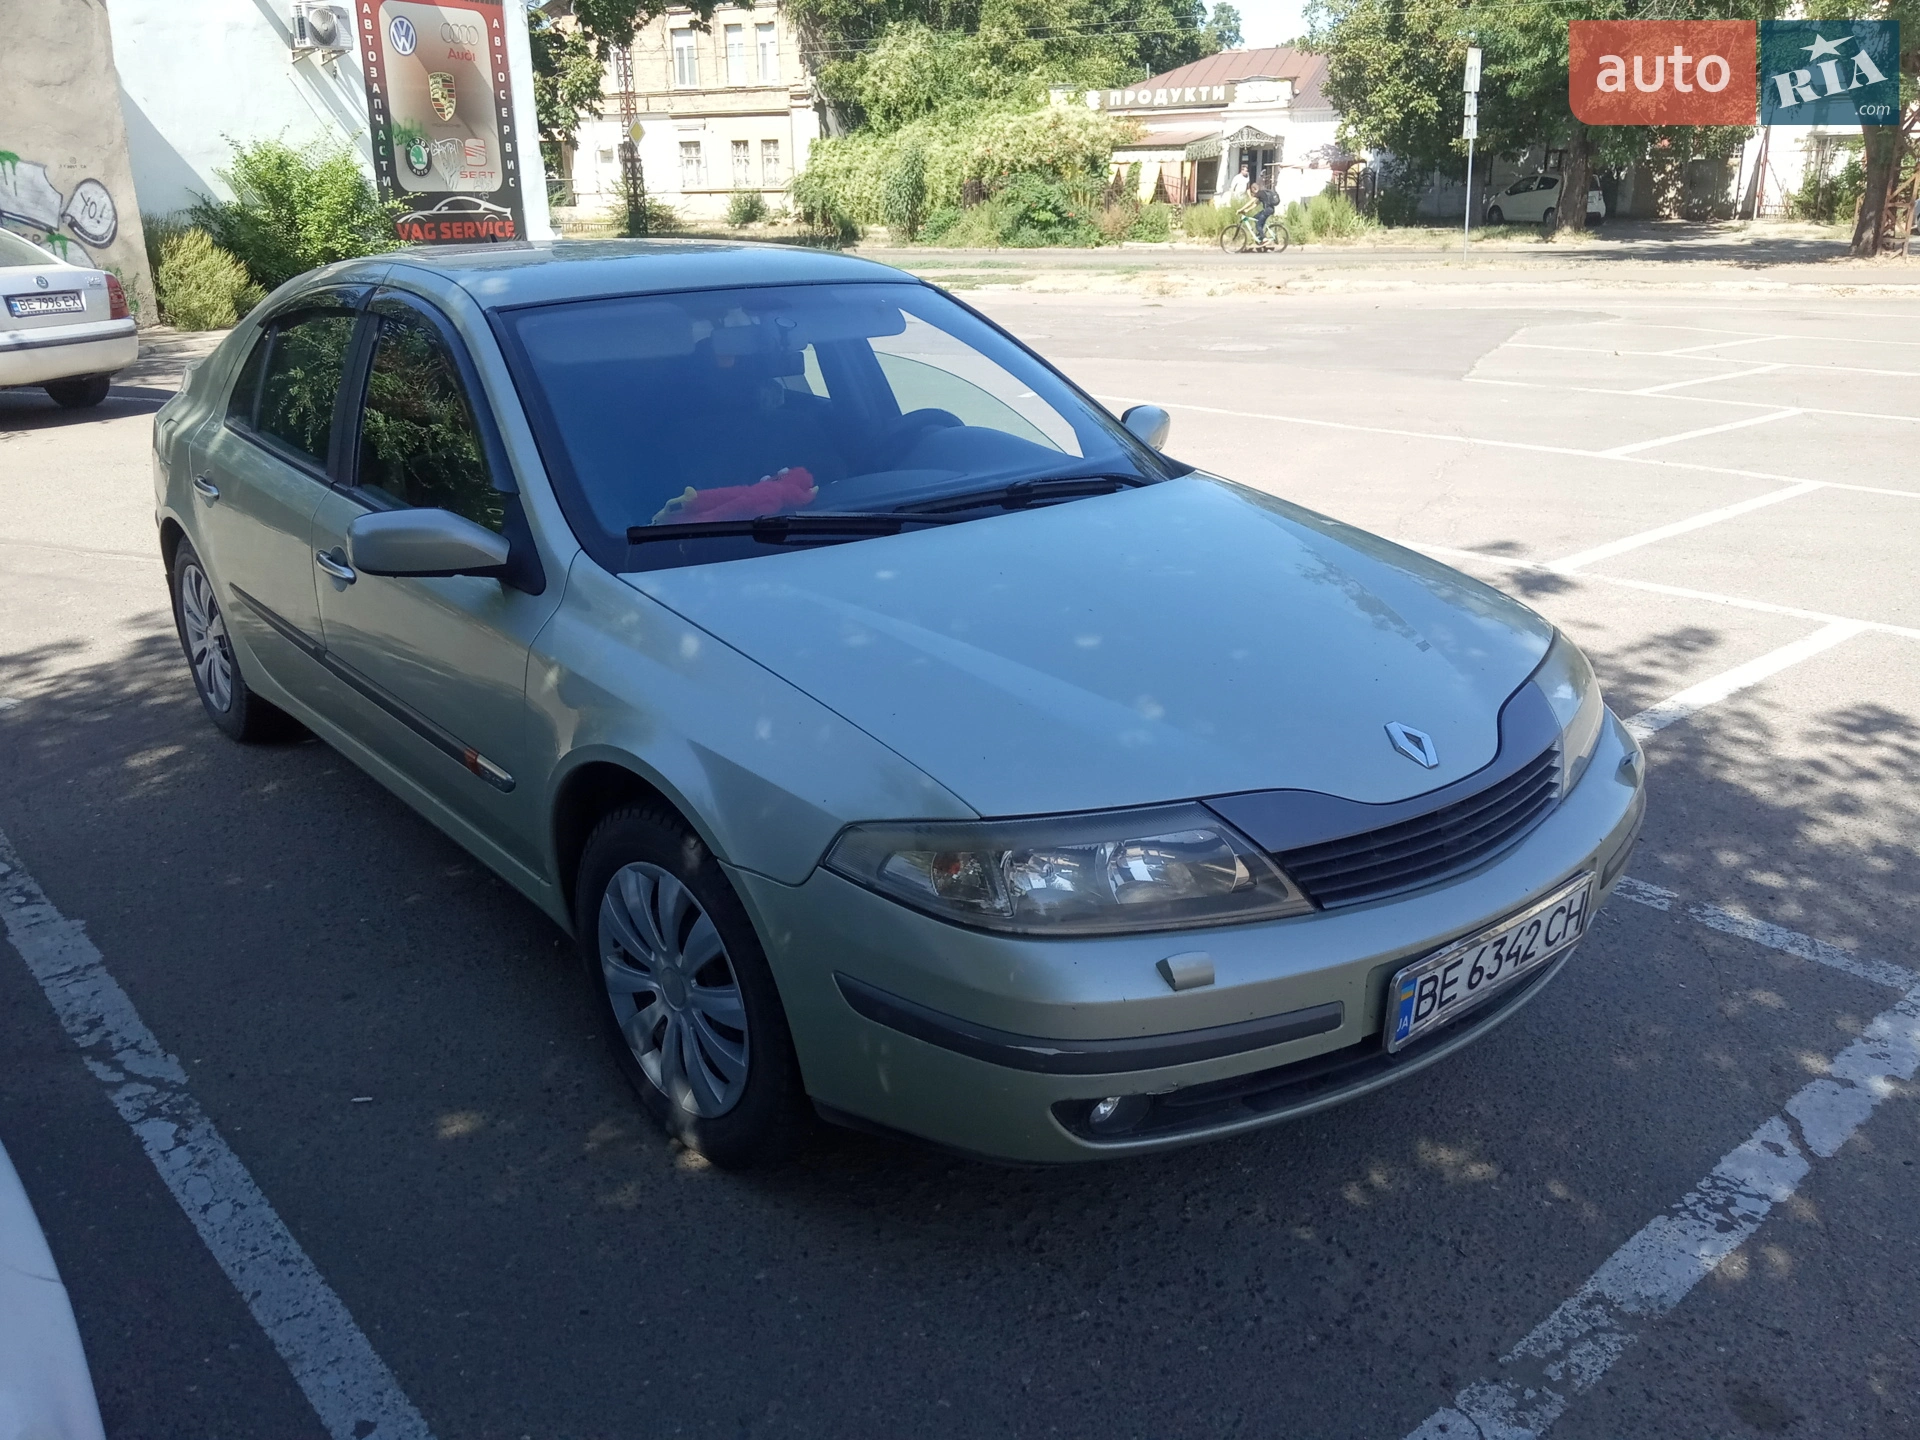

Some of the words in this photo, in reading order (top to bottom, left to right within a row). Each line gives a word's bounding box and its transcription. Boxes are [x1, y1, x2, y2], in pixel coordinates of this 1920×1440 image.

[447, 47, 476, 61] Audi
[362, 2, 391, 187] АВТОЗАПЧАСТИ
[492, 18, 515, 187] АВТОСЕРВИС
[1109, 85, 1225, 106] ПРОДУКТИ
[396, 222, 436, 240] VAG
[440, 221, 515, 239] SERVICE
[18, 298, 35, 311] BE
[35, 297, 62, 309] 7996
[62, 295, 79, 307] EX
[1413, 958, 1463, 1024] BE
[1467, 919, 1541, 990] 6342
[1545, 891, 1587, 948] CH
